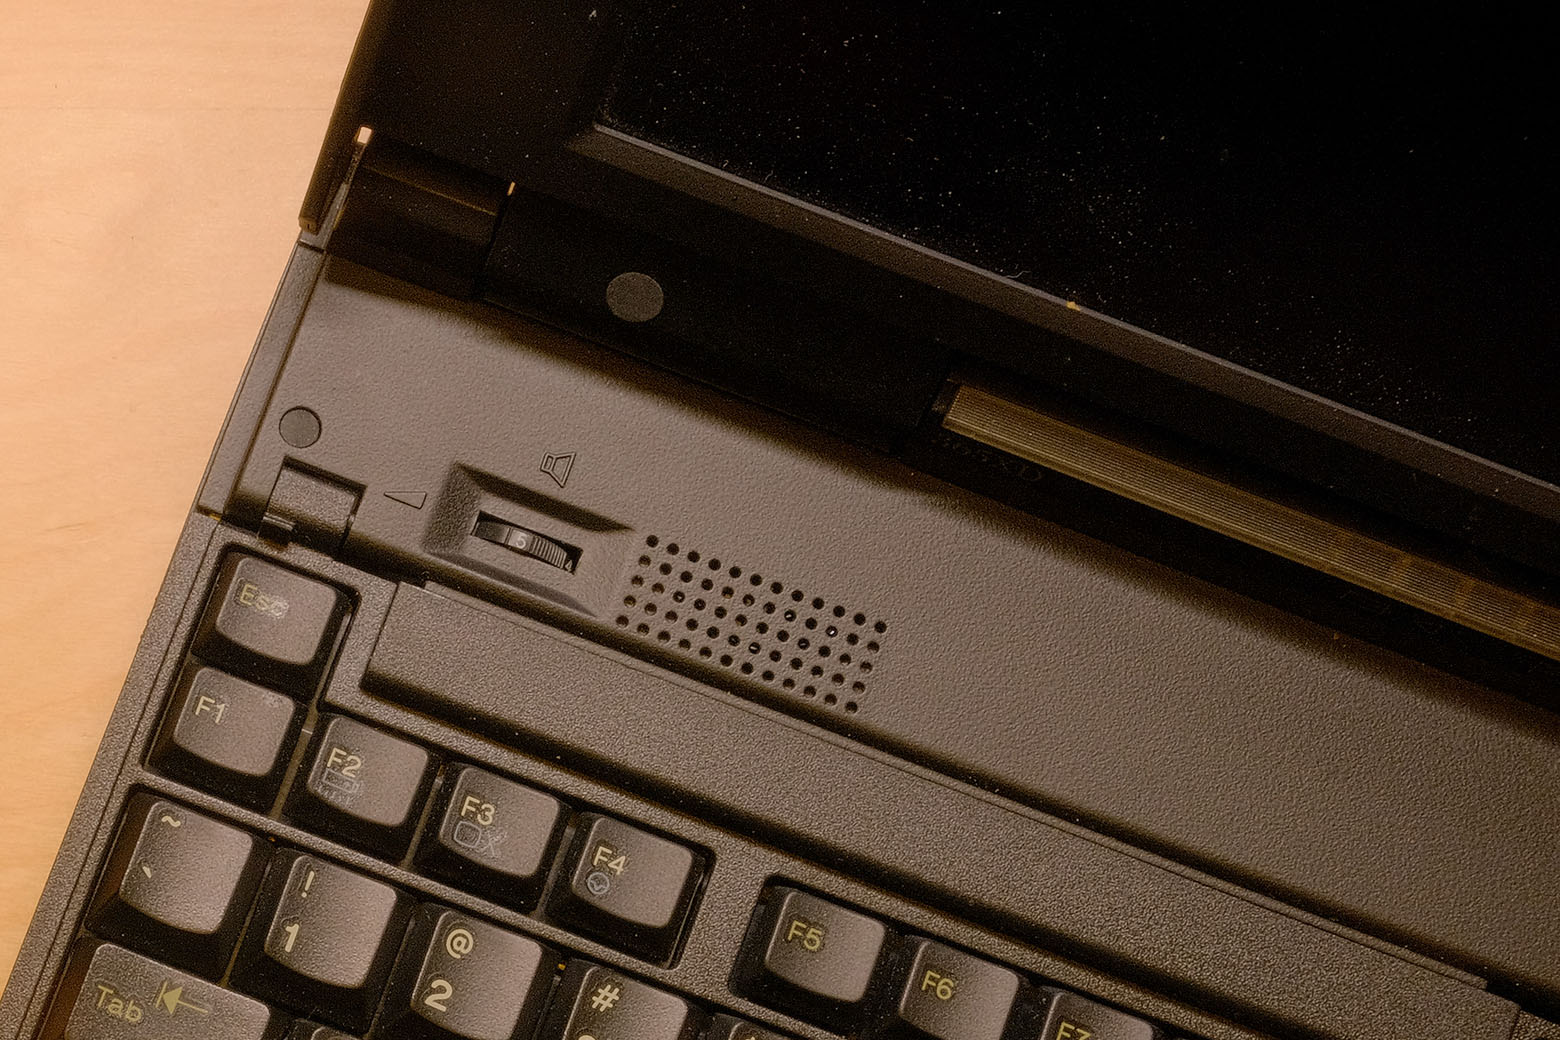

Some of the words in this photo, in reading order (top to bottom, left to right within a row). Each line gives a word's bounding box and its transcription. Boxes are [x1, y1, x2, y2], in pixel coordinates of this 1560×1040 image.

[515, 533, 527, 549] 5
[196, 696, 226, 723] F1
[327, 747, 362, 776] F2
[462, 797, 494, 825] F3
[594, 847, 625, 875] F4
[302, 871, 314, 897] !
[285, 924, 299, 952] 1
[447, 929, 473, 958] @
[788, 921, 822, 950] F5
[425, 980, 452, 1011] 2
[593, 985, 619, 1011] #
[922, 971, 954, 999] F6
[98, 985, 142, 1022] Tab
